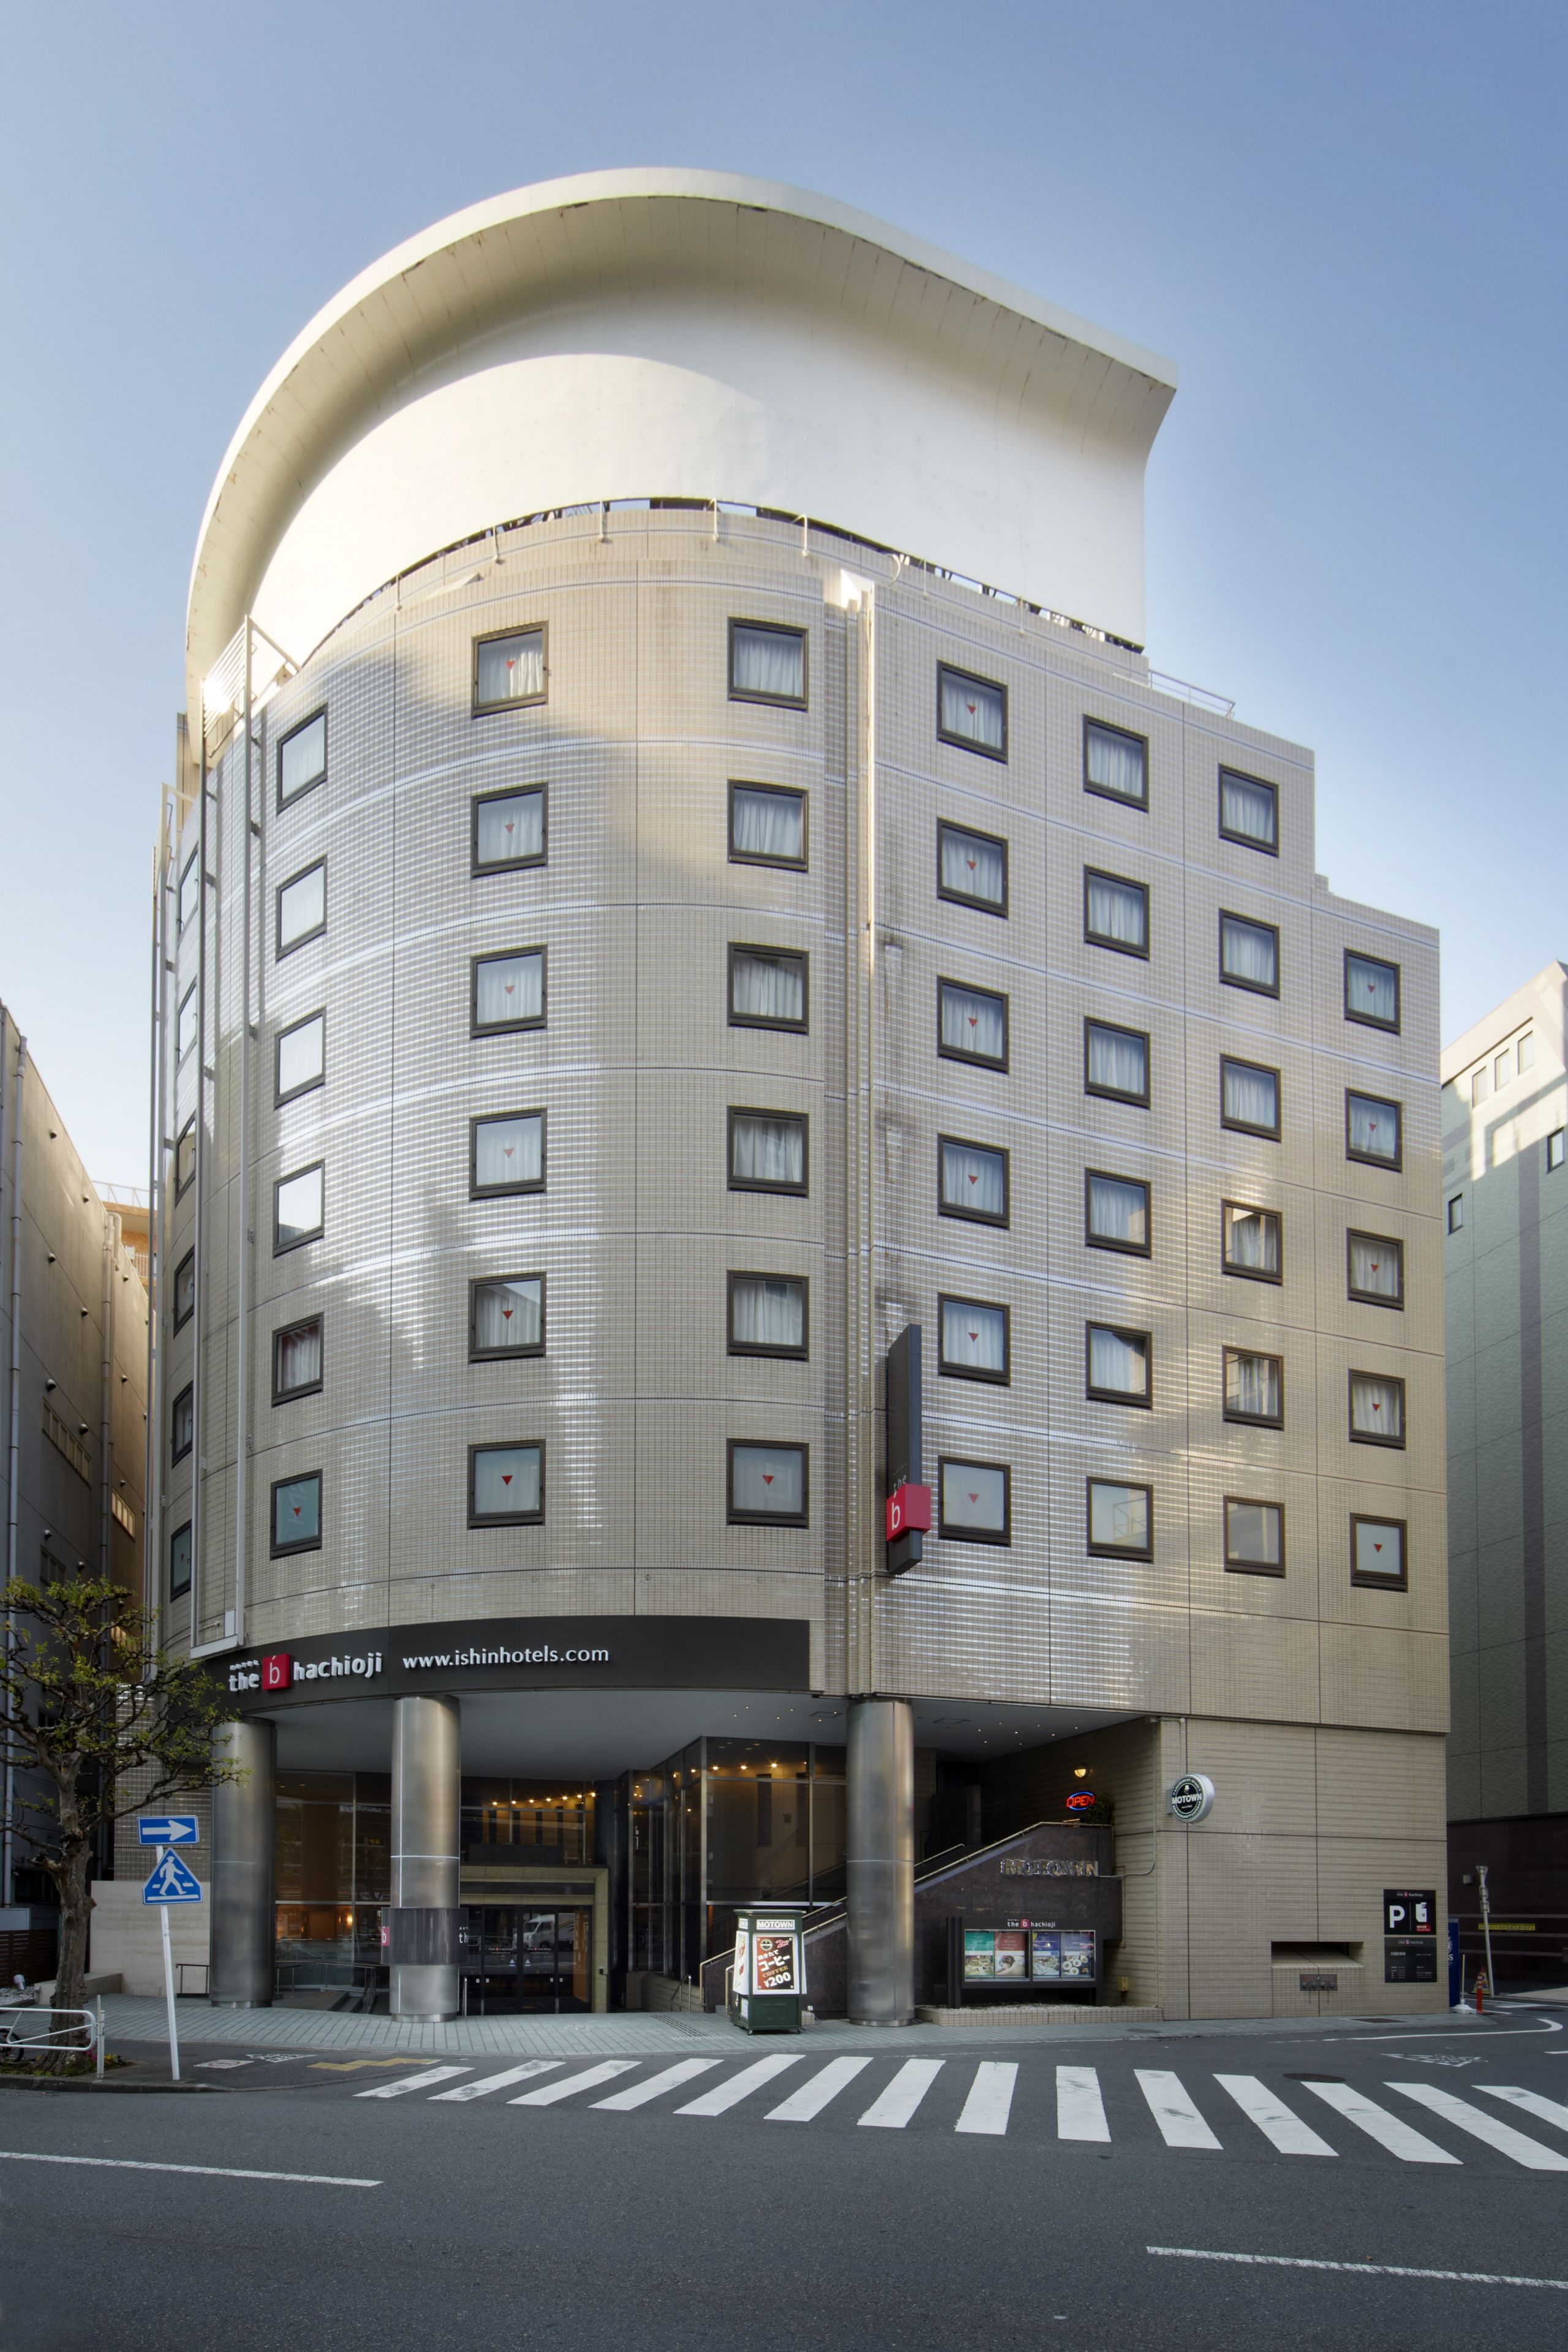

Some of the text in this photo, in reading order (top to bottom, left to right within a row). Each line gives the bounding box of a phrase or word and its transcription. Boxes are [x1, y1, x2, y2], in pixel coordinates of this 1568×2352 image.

[402, 1645, 609, 1669] www.ishinhotels.com
[228, 1672, 260, 1692] the
[293, 1652, 383, 1678] hachioji
[1066, 1795, 1095, 1807] OPEN
[1172, 1793, 1202, 1804] MOTOWN
[1001, 1859, 1099, 1877] MOTOWN
[1389, 1905, 1405, 1928] P
[758, 1955, 791, 1972] コーヒー
[763, 1965, 789, 1978] COFFEE
[764, 1972, 791, 1988] ¥200
